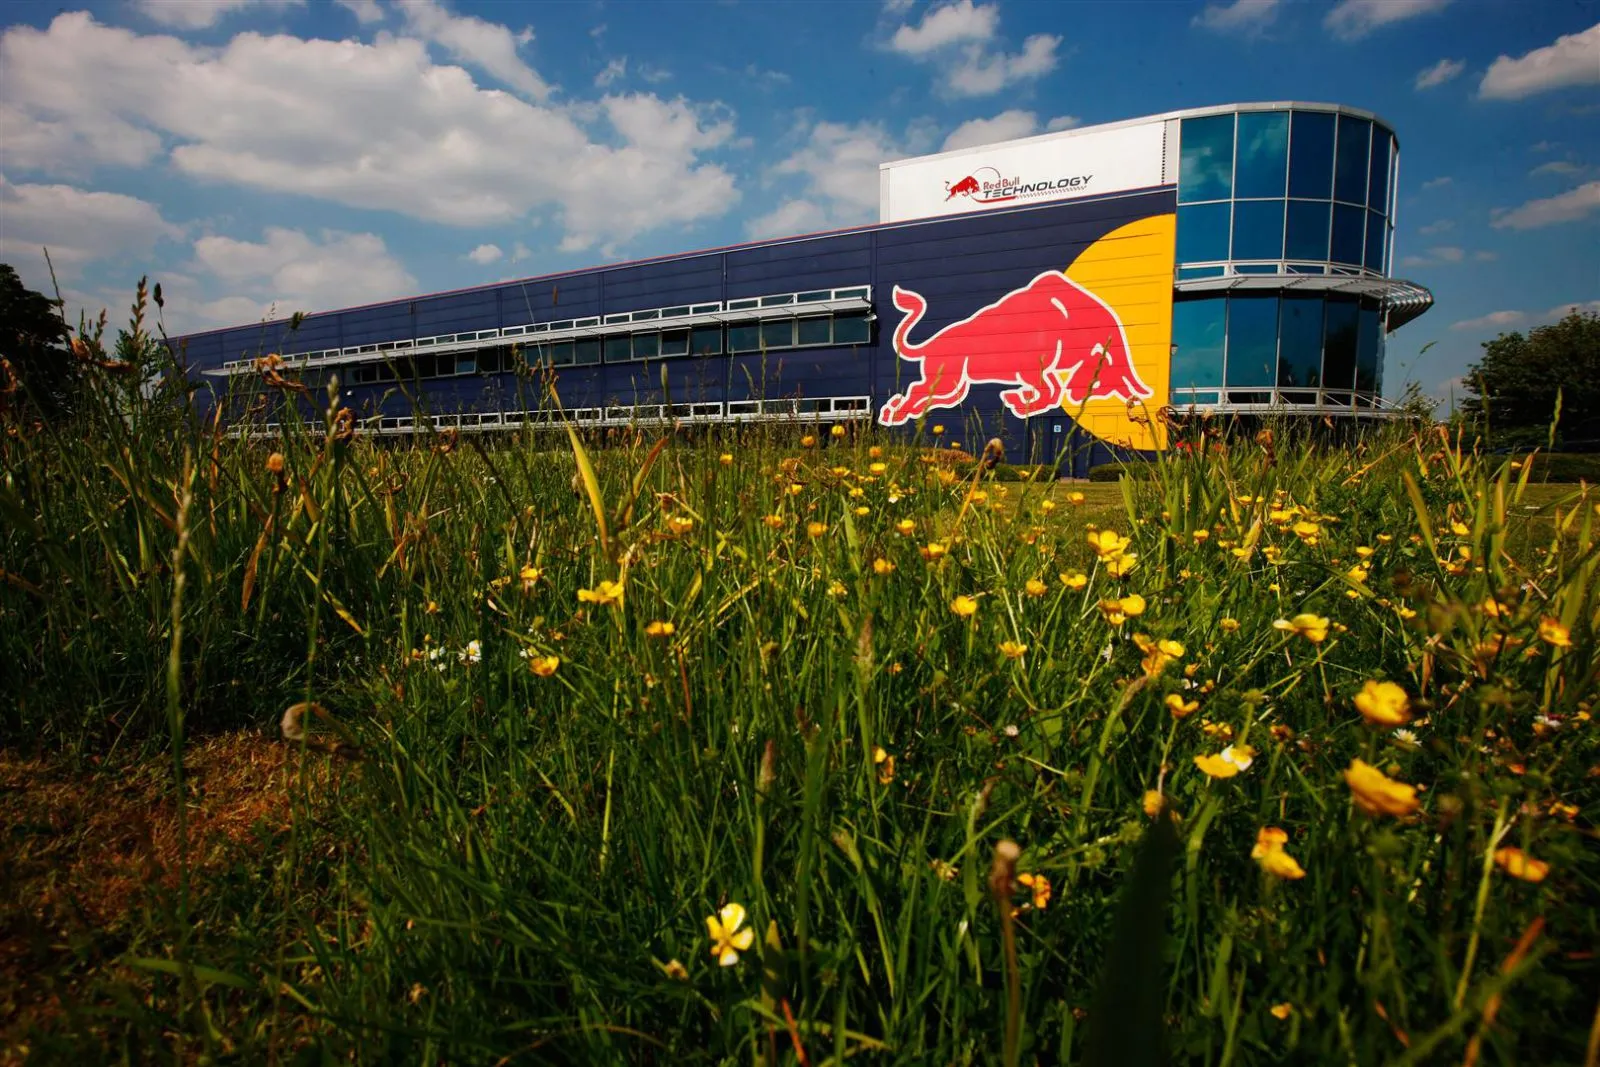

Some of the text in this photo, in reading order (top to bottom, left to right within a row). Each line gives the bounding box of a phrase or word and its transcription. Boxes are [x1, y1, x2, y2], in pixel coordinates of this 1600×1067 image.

[983, 176, 1020, 190] Red Bull
[983, 175, 1093, 198] TECHNOLOGY
